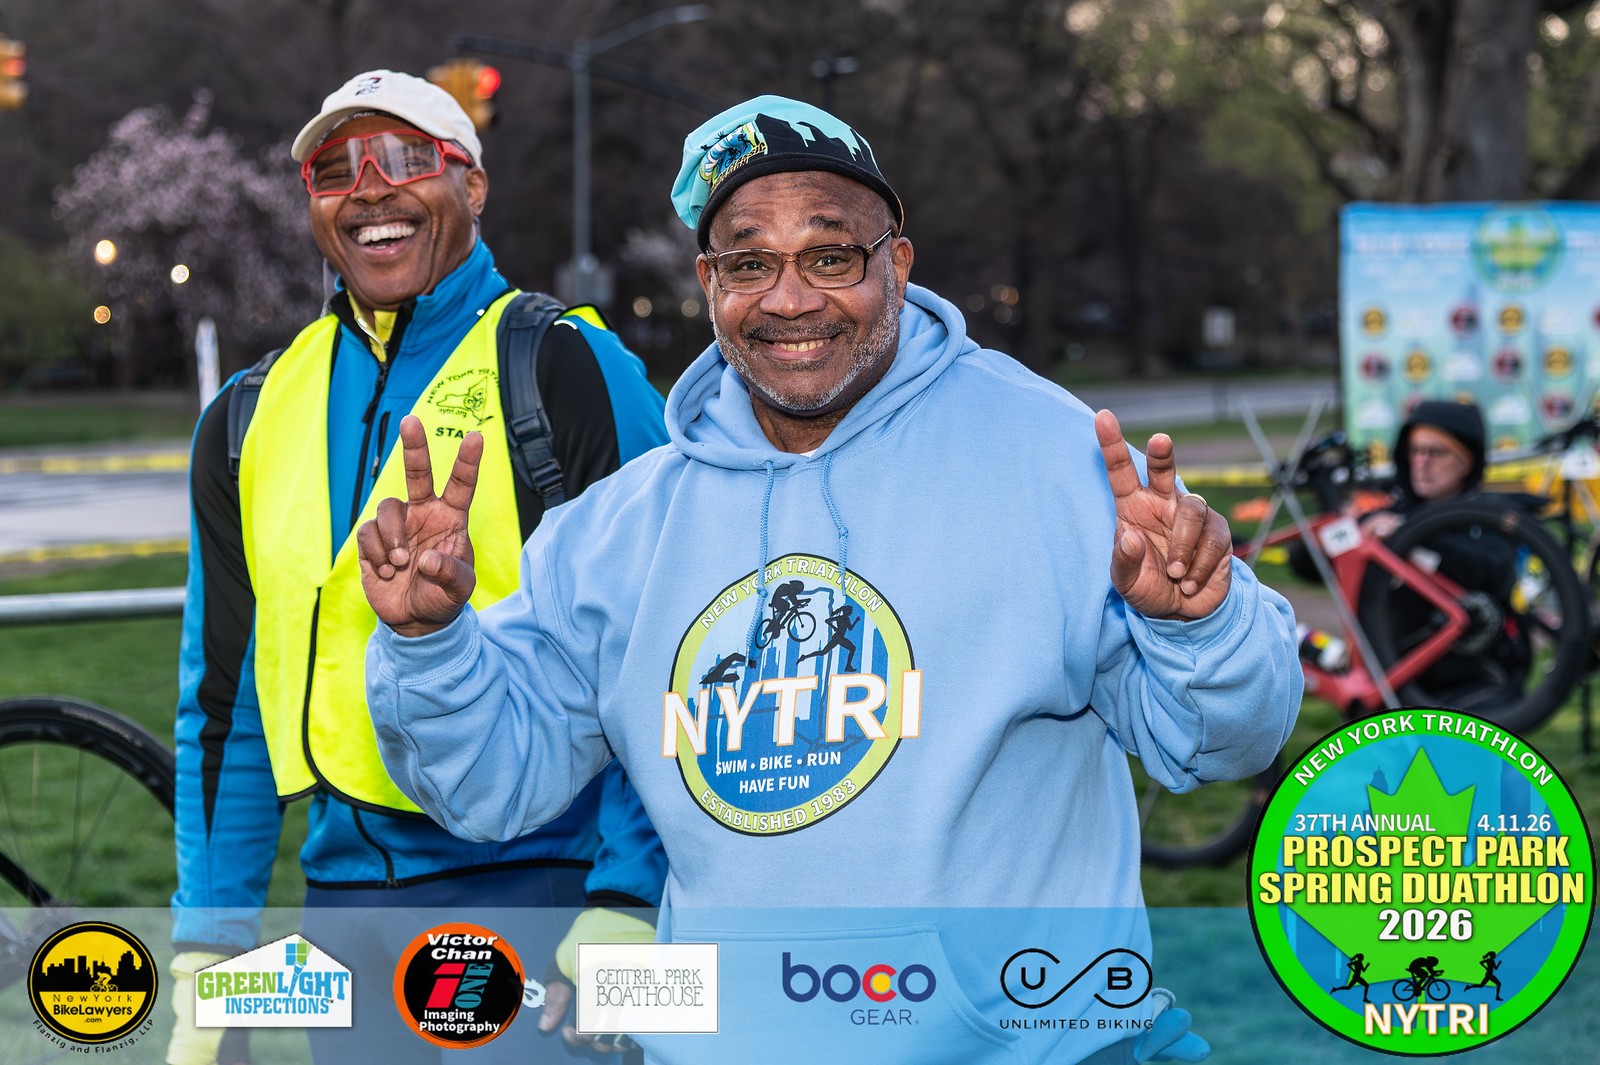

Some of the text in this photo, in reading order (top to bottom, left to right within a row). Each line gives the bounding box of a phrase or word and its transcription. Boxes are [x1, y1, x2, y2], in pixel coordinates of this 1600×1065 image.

[701, 558, 884, 629] NEW YORK TRIATHLON
[662, 669, 923, 758] NYTRI
[715, 751, 841, 777] SWIM BIKE RUN
[739, 775, 810, 794] HAVE FUN
[700, 778, 857, 831] ESTABLISHED 1983
